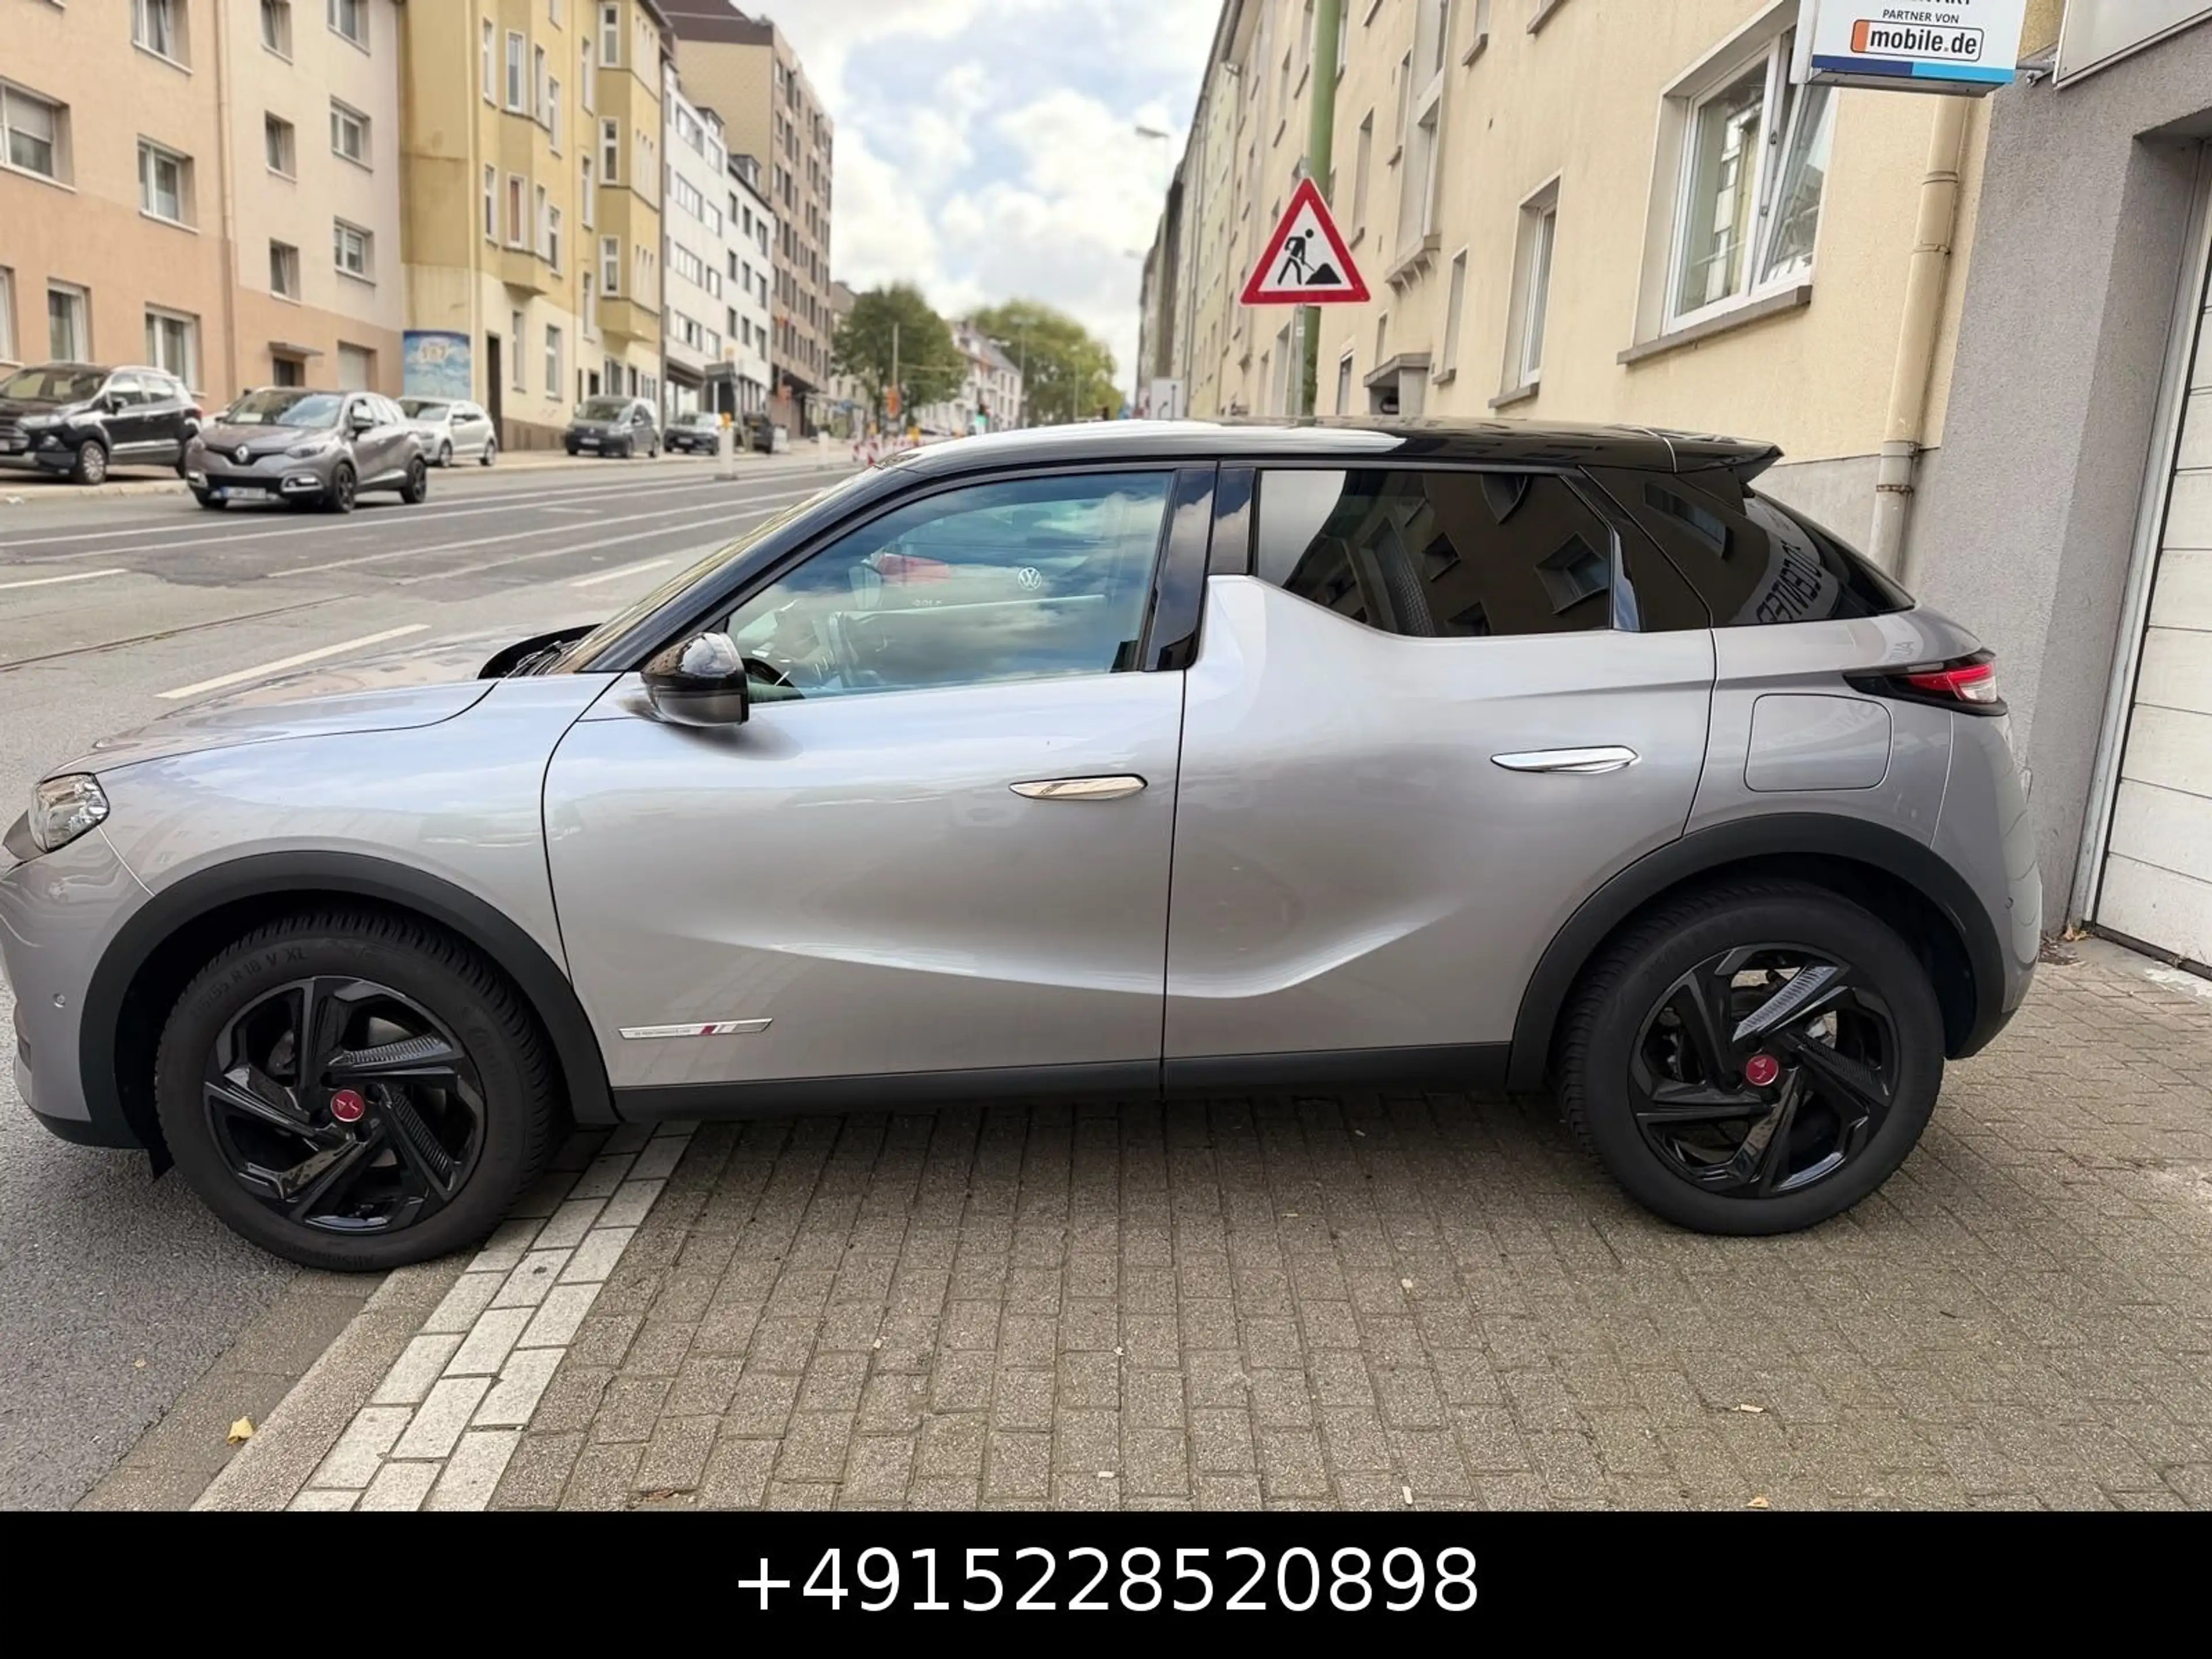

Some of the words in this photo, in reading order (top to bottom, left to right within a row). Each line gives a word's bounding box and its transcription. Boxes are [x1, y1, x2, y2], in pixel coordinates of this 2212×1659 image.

[1882, 9, 1932, 22] PARTNER
[1935, 13, 1960, 24] VON
[1870, 28, 1978, 55] mobile.de
